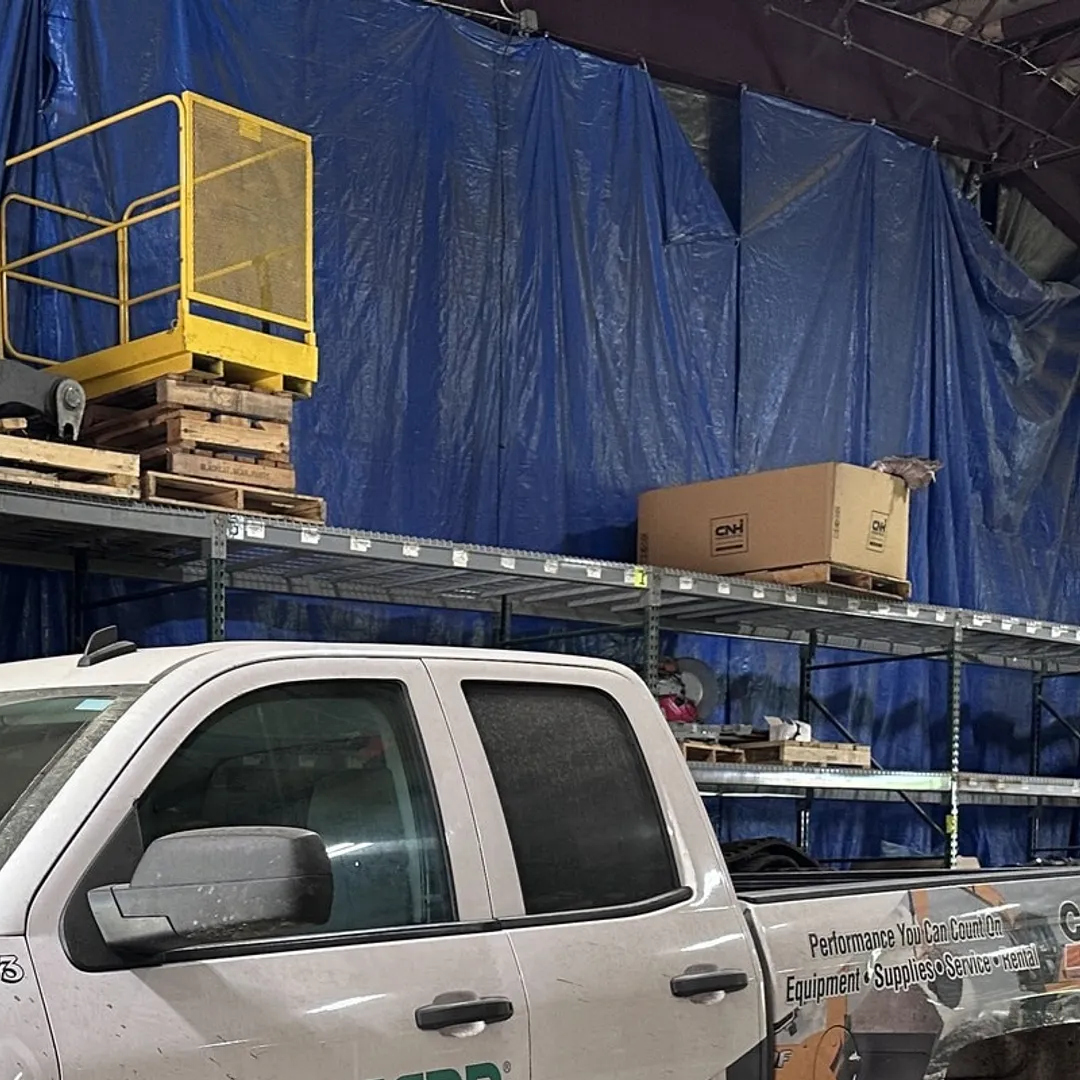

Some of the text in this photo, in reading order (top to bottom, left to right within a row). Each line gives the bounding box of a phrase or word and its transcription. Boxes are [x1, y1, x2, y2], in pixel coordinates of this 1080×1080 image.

[808, 914, 1003, 958] Performance You Can Count On
[786, 969, 861, 1003] Equipment
[874, 956, 934, 991] Supplies
[945, 951, 991, 978] Service
